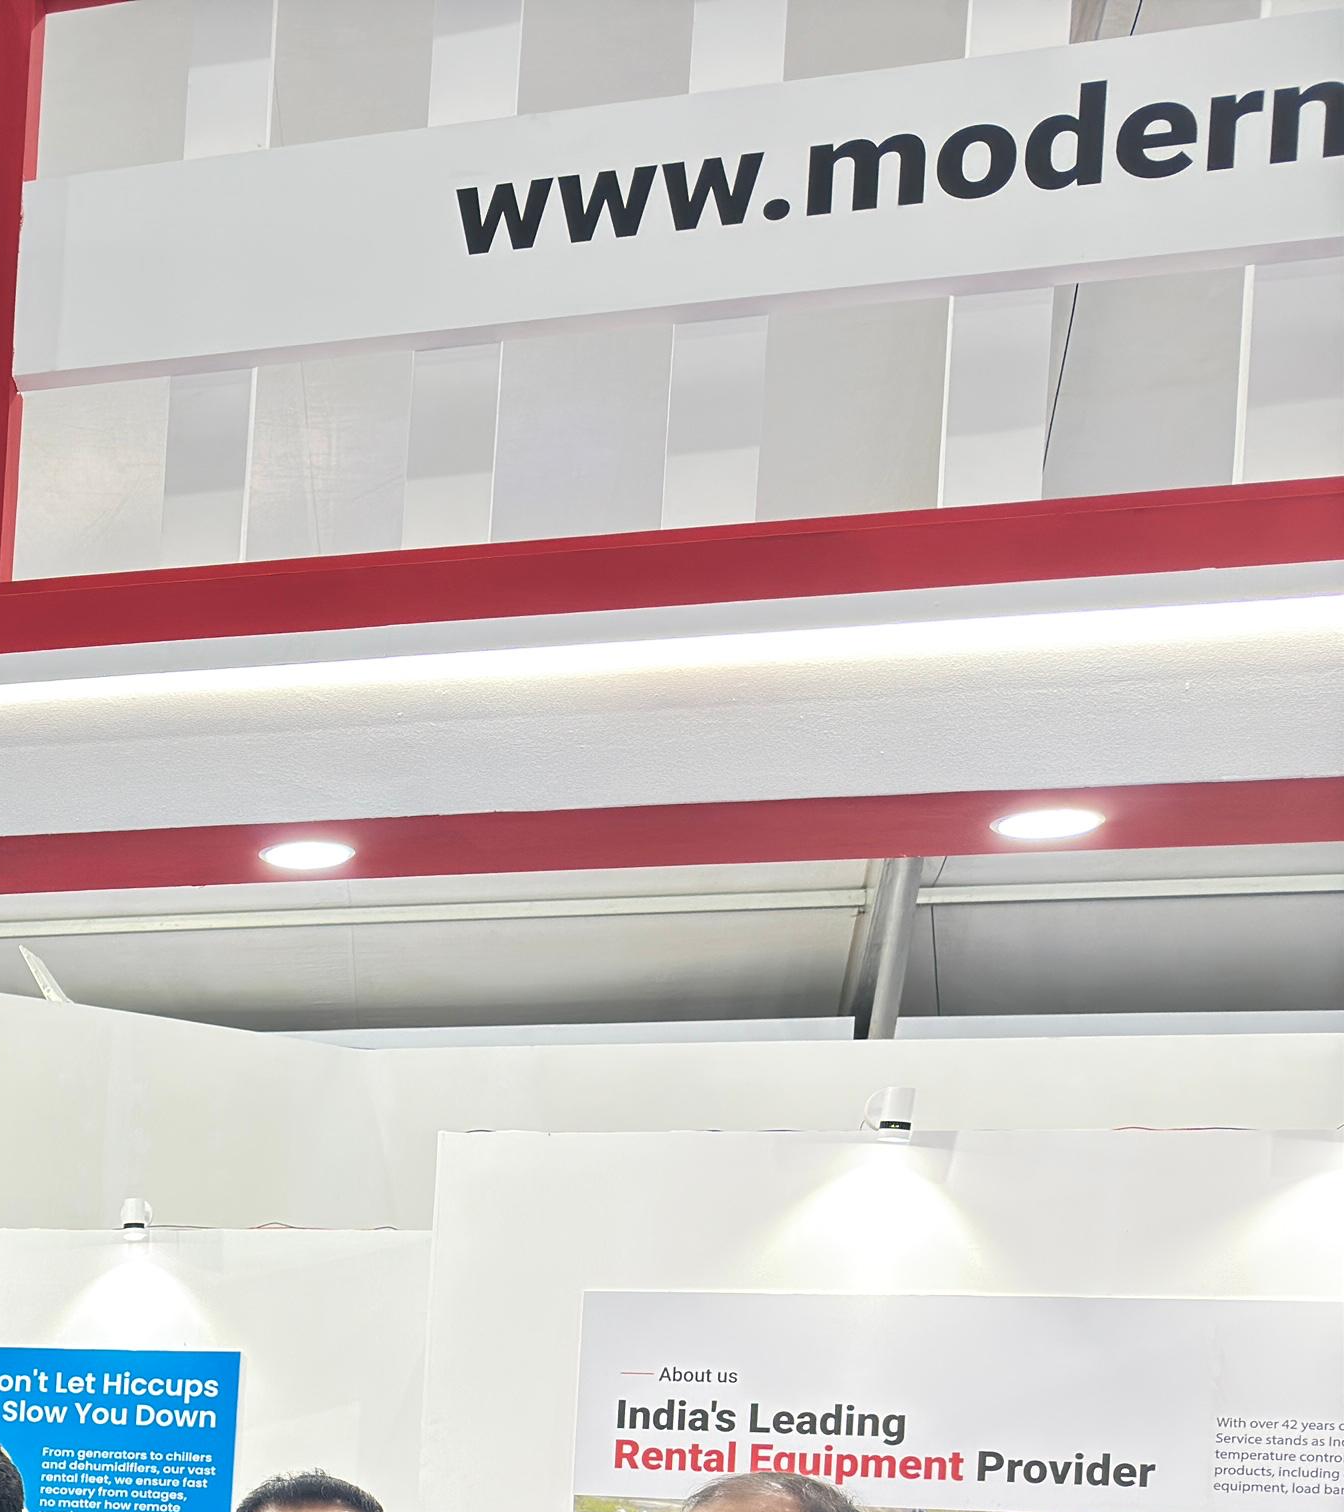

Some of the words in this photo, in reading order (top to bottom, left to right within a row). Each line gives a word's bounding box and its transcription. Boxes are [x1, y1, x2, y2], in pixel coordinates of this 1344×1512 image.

[456, 80, 1344, 256] www.modern
[659, 1367, 712, 1384] About
[717, 1371, 738, 1384] us
[56, 1371, 95, 1394] Let
[103, 1371, 219, 1403] Hiccups
[2, 1400, 67, 1423] Slow
[75, 1402, 127, 1425] You
[136, 1404, 217, 1428] Down
[616, 1399, 737, 1433] India's
[749, 1402, 906, 1446] Leading
[1217, 1417, 1246, 1429] With
[1250, 1420, 1279, 1429] over
[1282, 1419, 1298, 1430] 42
[1301, 1422, 1335, 1432] years
[1215, 1433, 1263, 1445] Service
[1266, 1435, 1308, 1446] stands
[1311, 1438, 1325, 1446] as
[42, 1446, 75, 1458] From
[77, 1449, 147, 1461] generators
[150, 1450, 163, 1462] to
[165, 1451, 212, 1463] chillers
[1215, 1449, 1297, 1462] temperature
[41, 1459, 66, 1470] and
[69, 1460, 160, 1476] dehumidifiers,
[163, 1465, 185, 1475] our
[187, 1465, 217, 1476] vast
[614, 1439, 737, 1474] Rental
[750, 1443, 964, 1484] Equipment
[977, 1450, 1156, 1488] Provider
[40, 1472, 78, 1483] rental
[80, 1473, 112, 1486] fleet,
[114, 1477, 133, 1486] we
[135, 1477, 180, 1488] ensure
[182, 1477, 208, 1489] fast
[1214, 1465, 1275, 1478] products,
[1278, 1467, 1340, 1481] including
[40, 1486, 96, 1499] recovery
[97, 1487, 128, 1498] from
[131, 1489, 188, 1502] outages,
[1213, 1481, 1289, 1495] equipment,
[1292, 1483, 1321, 1494] load
[39, 1498, 56, 1508] no
[57, 1499, 102, 1510] matter
[104, 1501, 131, 1511] how
[133, 1502, 181, 1512] remote
